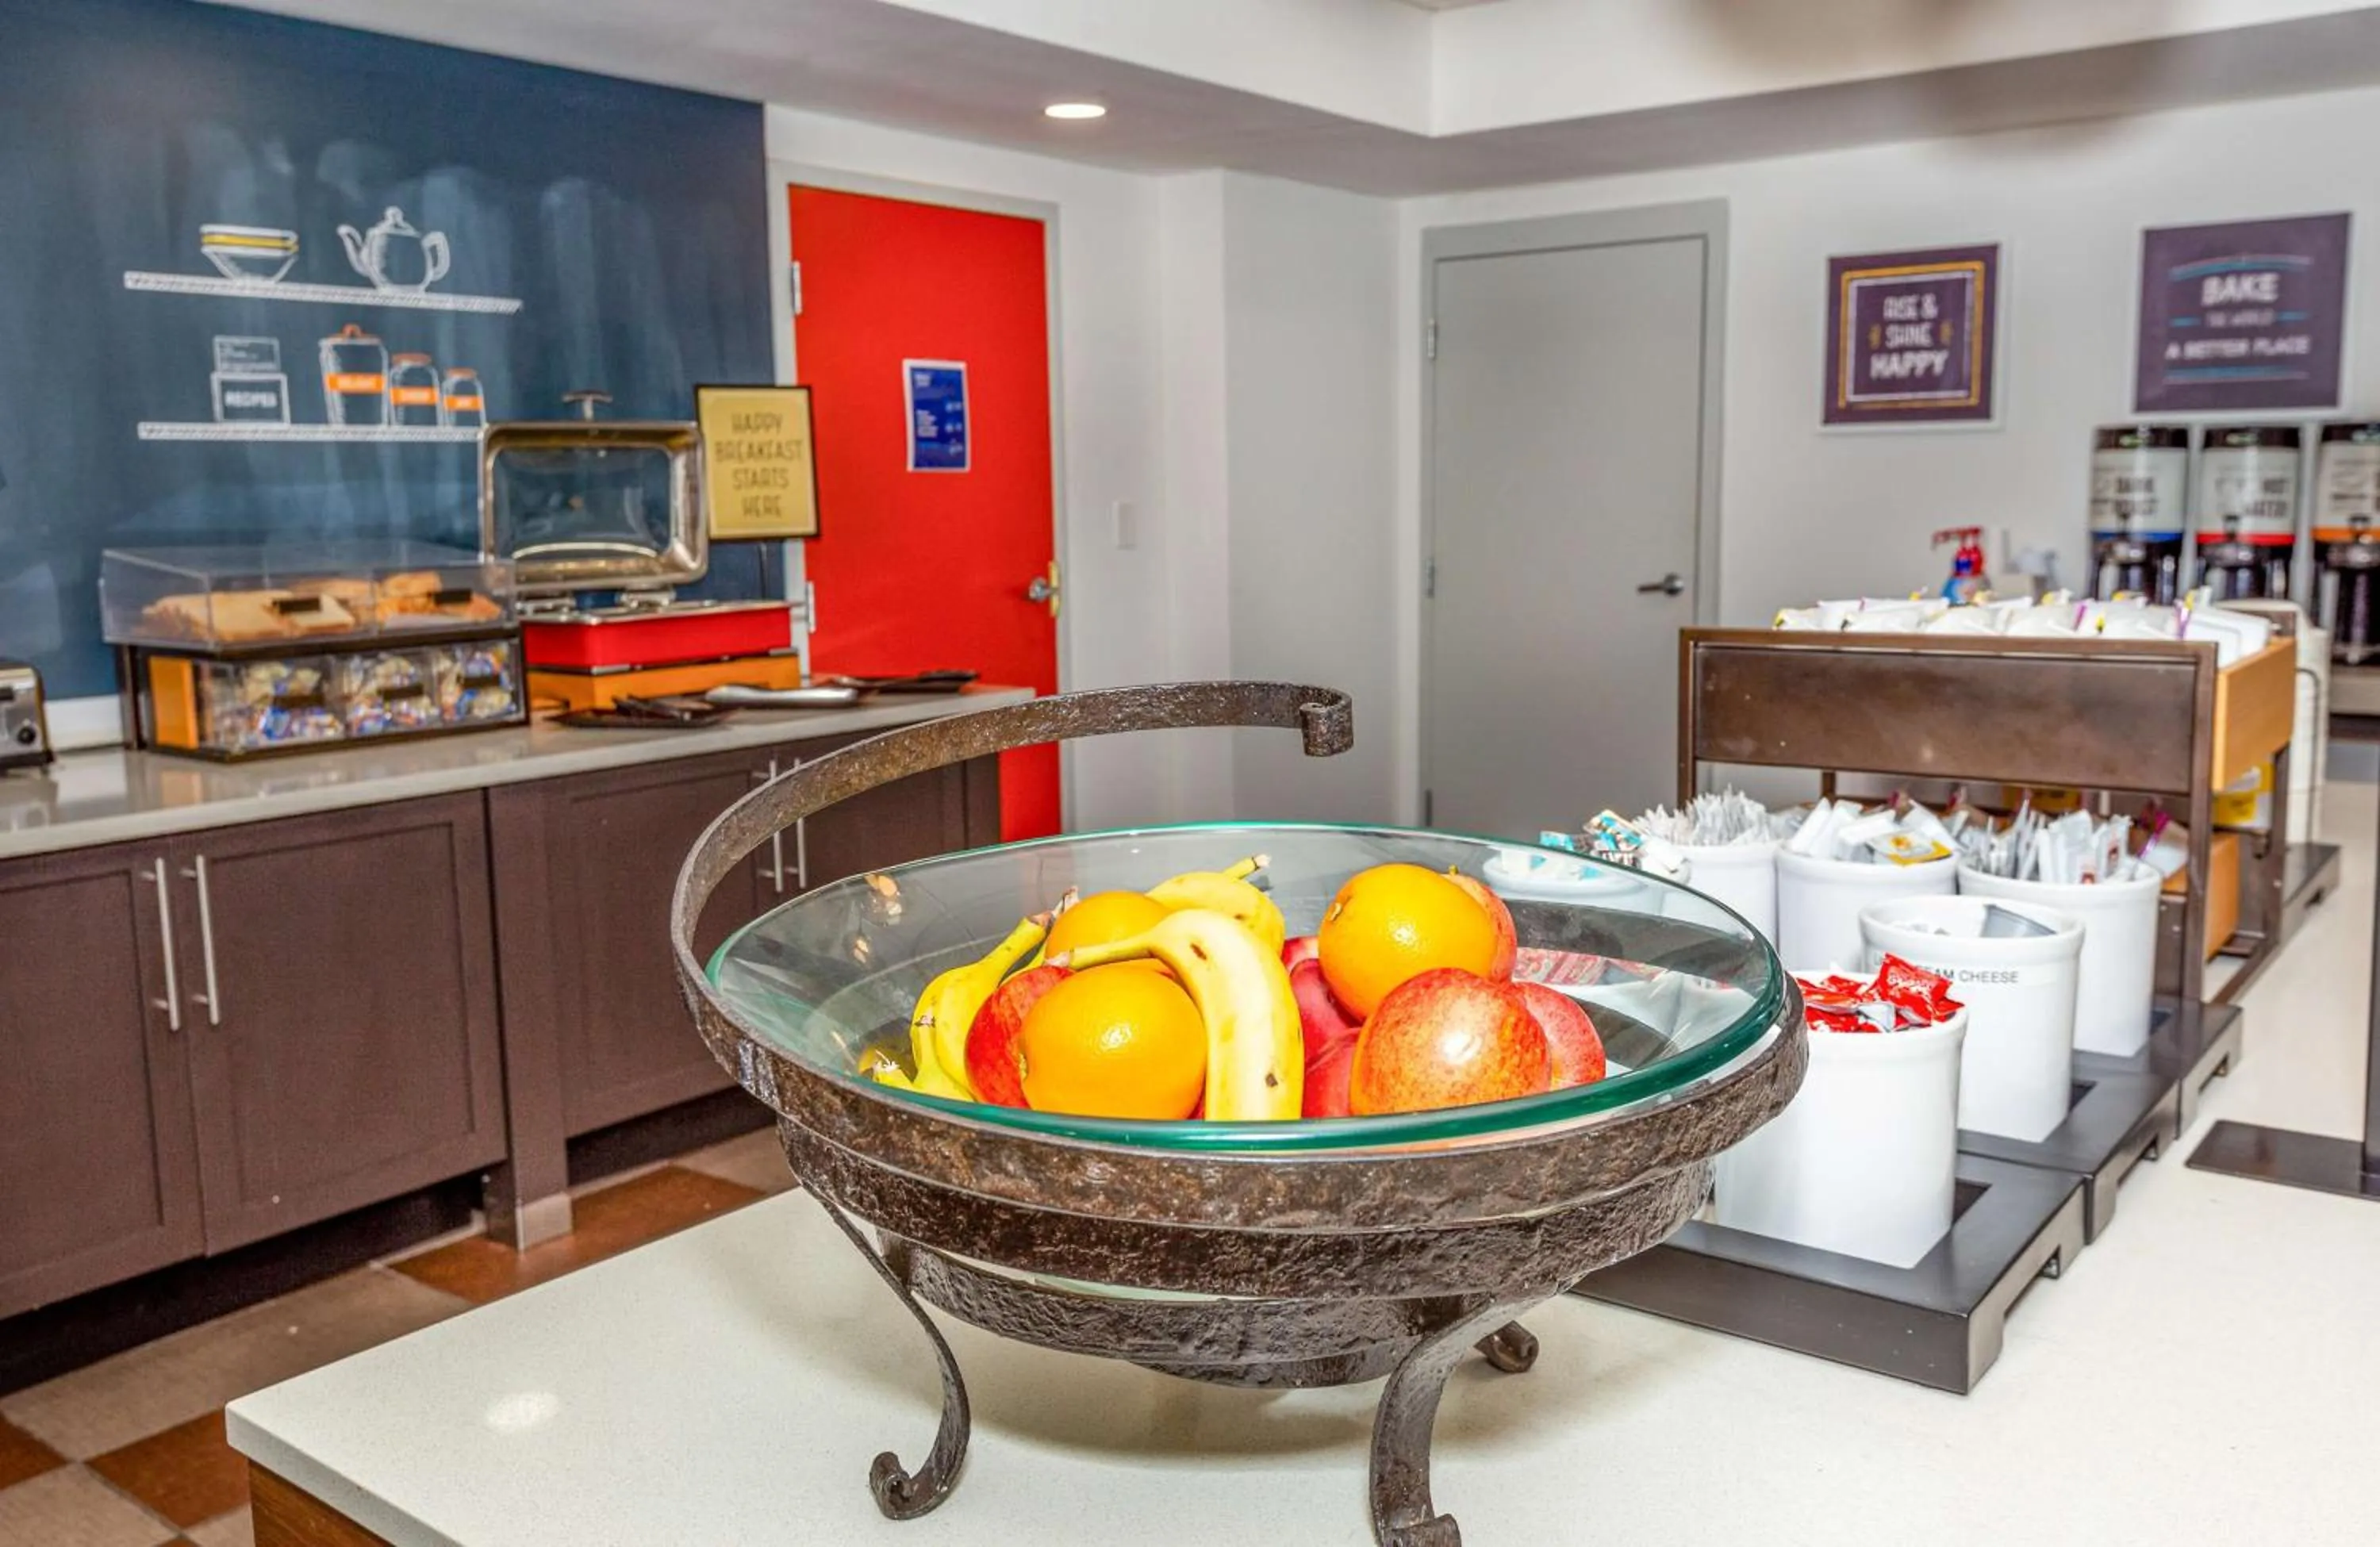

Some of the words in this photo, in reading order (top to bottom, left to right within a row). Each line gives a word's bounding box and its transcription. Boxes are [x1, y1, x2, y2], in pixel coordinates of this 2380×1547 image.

[2201, 272, 2280, 306] BAKE
[1921, 293, 1938, 320] &
[1885, 321, 1933, 348] SHINE
[2165, 343, 2180, 359] A
[2183, 339, 2250, 359] BETTER
[2252, 335, 2312, 355] PLACE
[1870, 350, 1949, 379] HAPPY
[731, 413, 783, 433] HAPPY
[715, 439, 804, 463] BREAKFAST
[732, 467, 790, 490] STARTS
[742, 494, 782, 518] HERE
[1958, 969, 2019, 984] CHEESE
